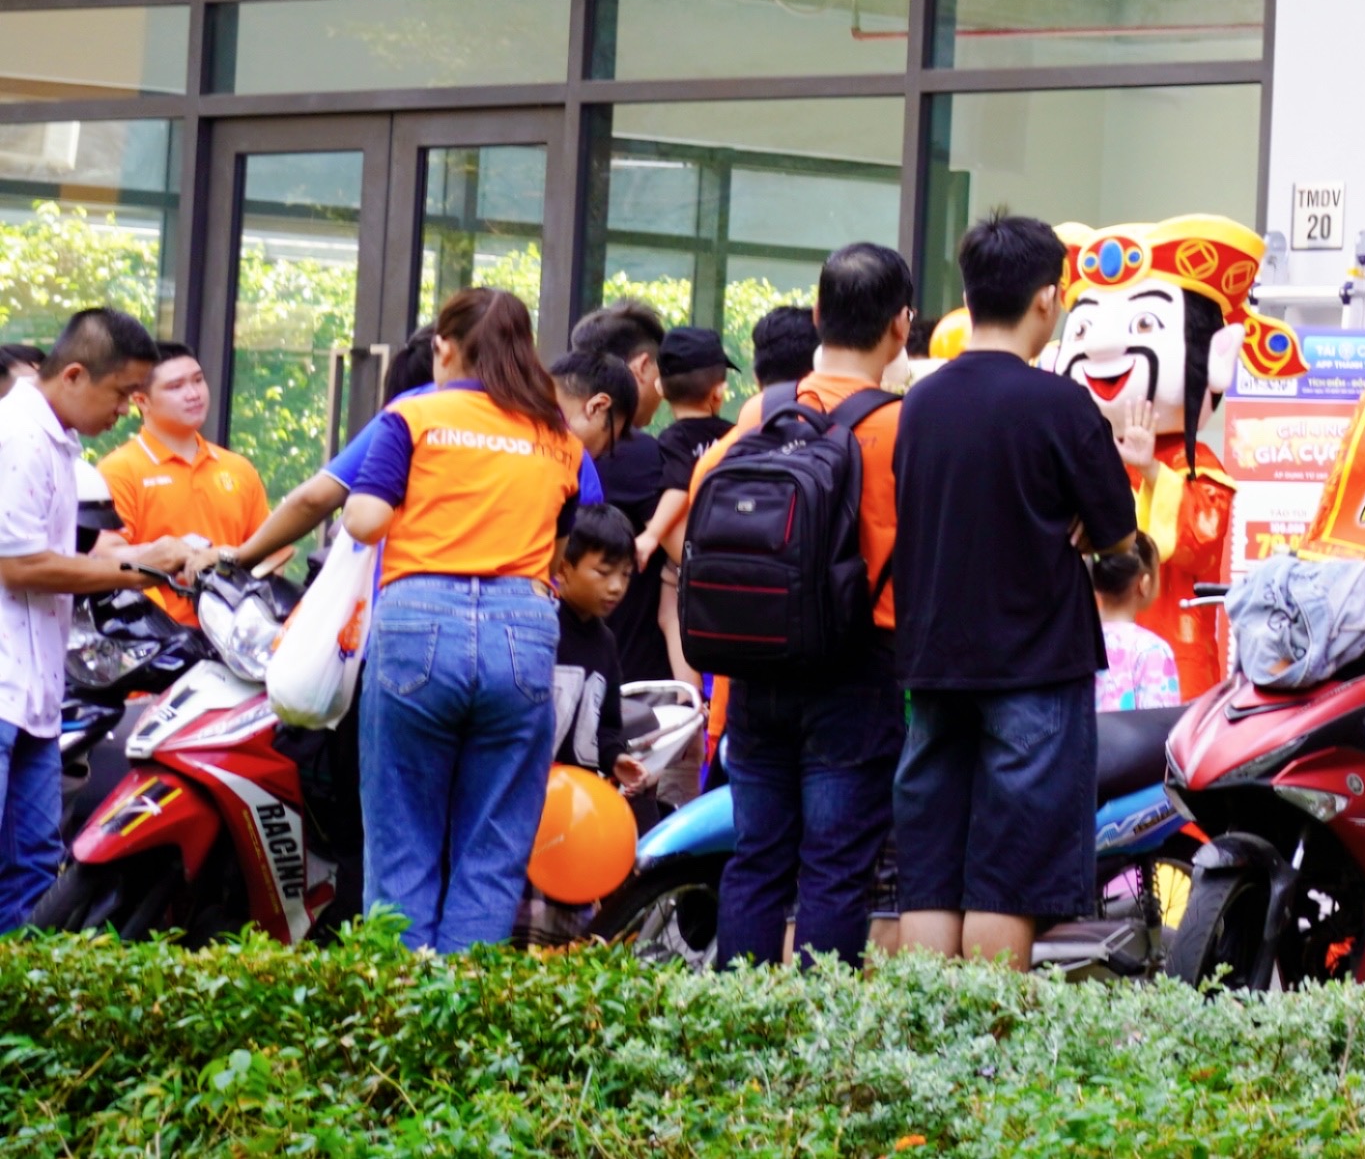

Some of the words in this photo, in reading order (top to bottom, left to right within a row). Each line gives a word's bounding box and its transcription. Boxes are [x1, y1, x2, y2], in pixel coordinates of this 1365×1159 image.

[1297, 188, 1341, 208] TMDV
[1307, 213, 1331, 240] 20
[1255, 440, 1293, 464] GIÁ
[256, 803, 306, 901] RACING
